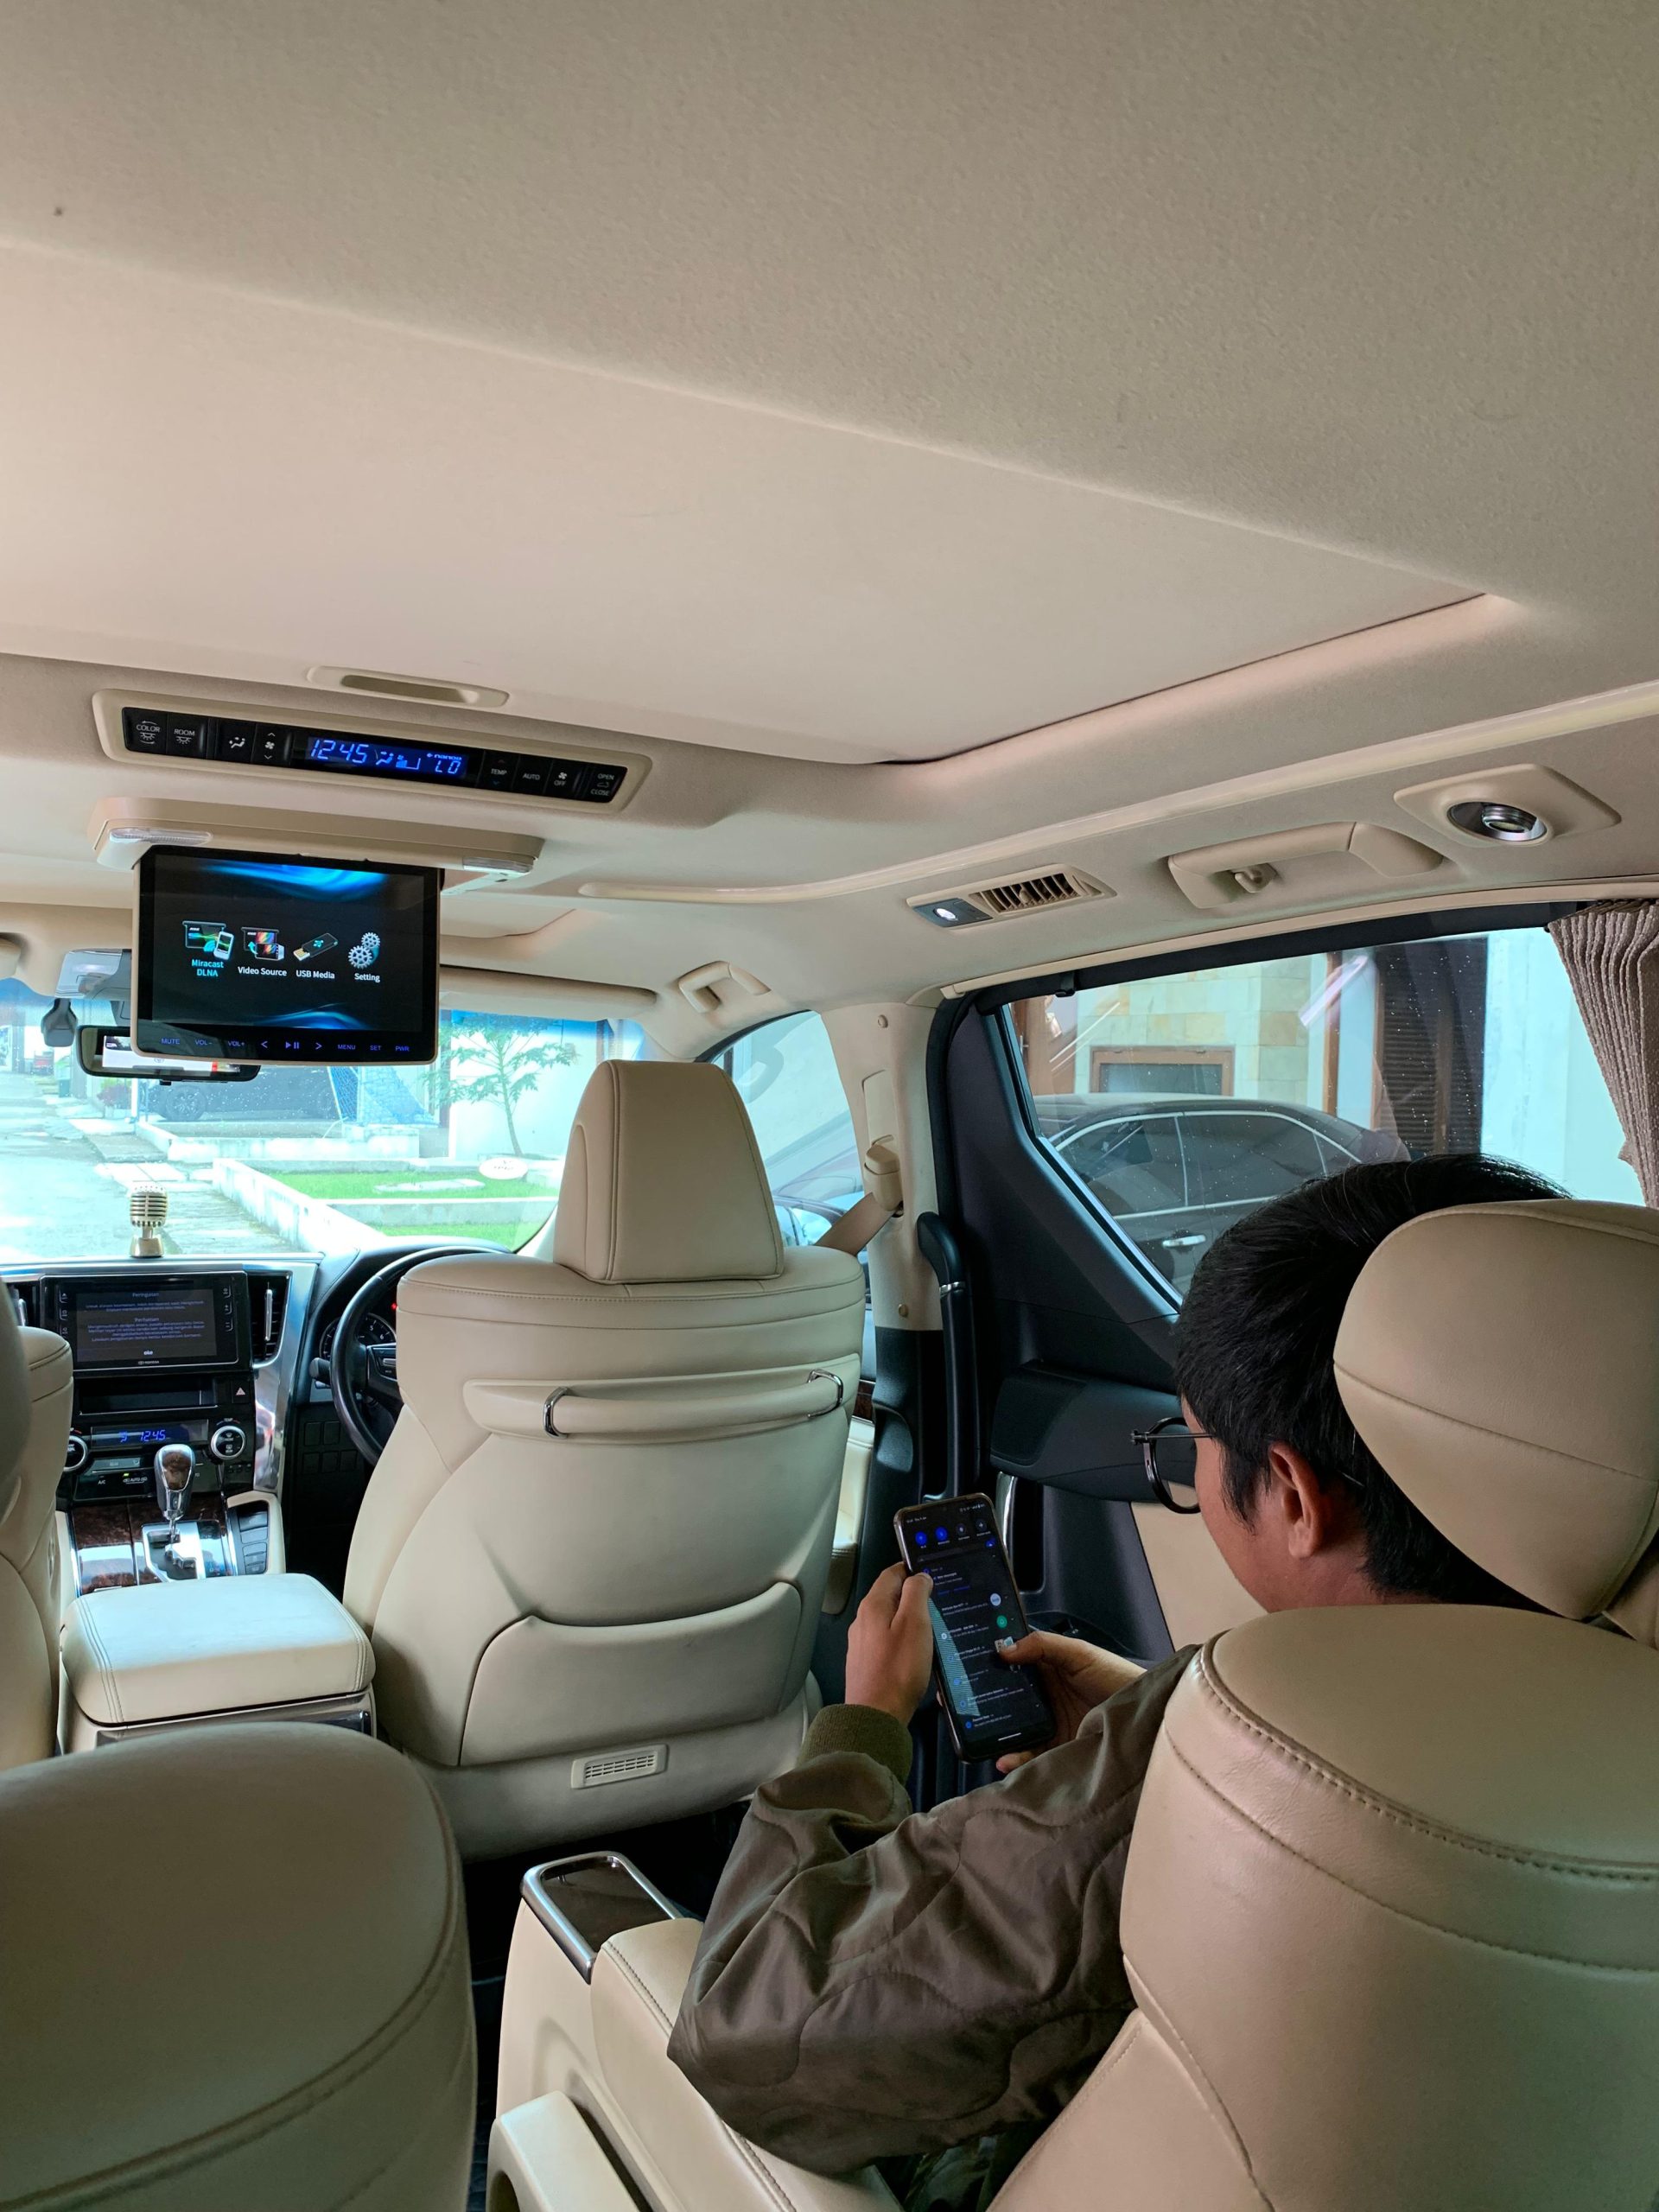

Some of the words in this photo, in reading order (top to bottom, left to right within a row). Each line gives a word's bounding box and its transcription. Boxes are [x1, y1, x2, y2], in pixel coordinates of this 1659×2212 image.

[136, 724, 161, 733] COLOR
[192, 959, 224, 968] Miracast
[238, 966, 259, 975] Video
[260, 968, 288, 976] Source
[313, 970, 335, 979] Media
[354, 973, 380, 983] Setting
